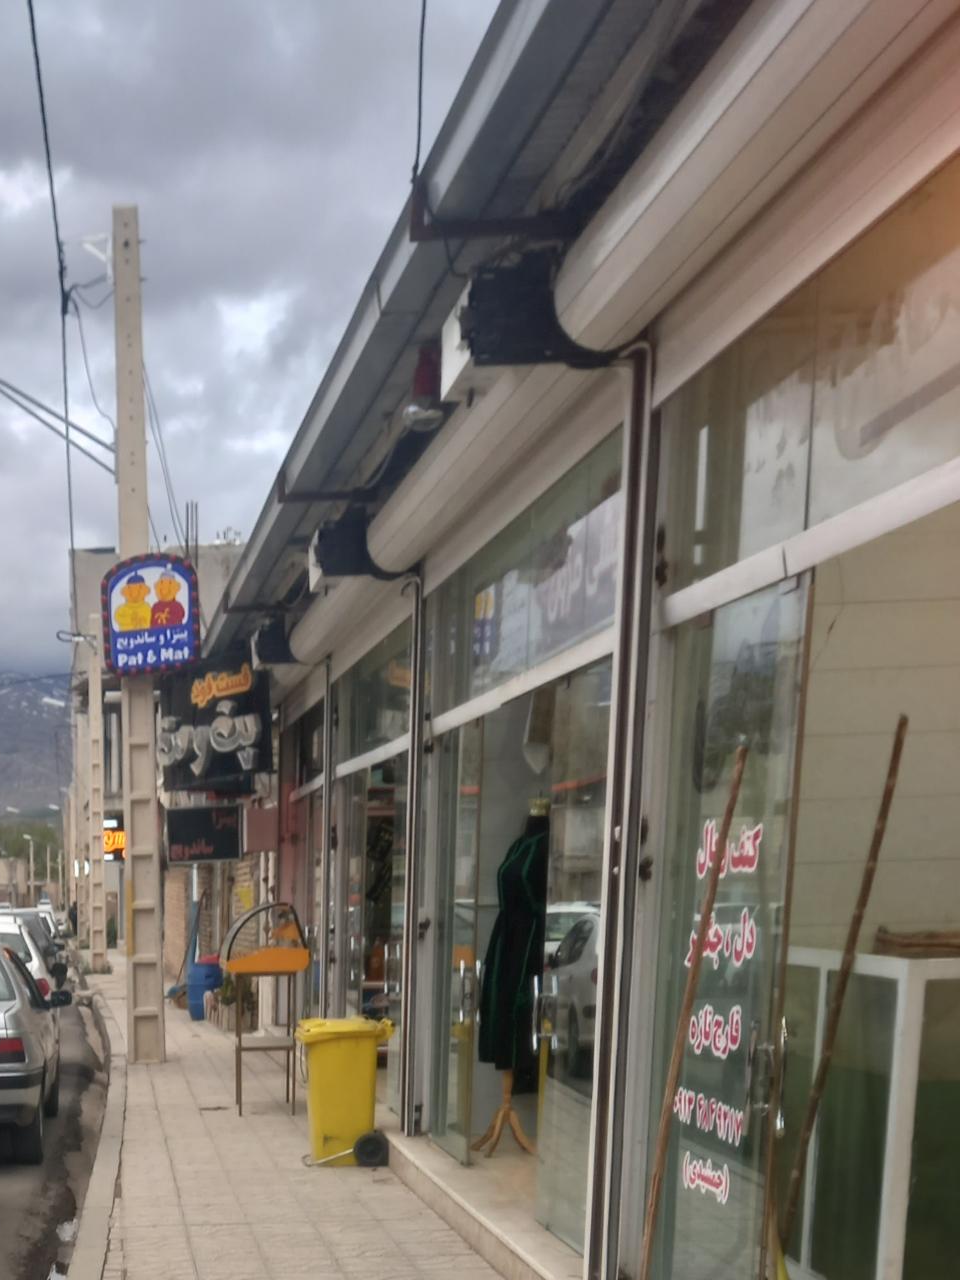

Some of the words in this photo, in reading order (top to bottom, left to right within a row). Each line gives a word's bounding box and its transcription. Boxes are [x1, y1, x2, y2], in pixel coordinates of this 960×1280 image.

[116, 631, 156, 650] ساندویچ
[159, 634, 165, 646] و
[166, 628, 188, 644] پیتزا
[117, 652, 143, 668] Pat
[146, 649, 157, 664] &
[160, 646, 189, 662] Mat
